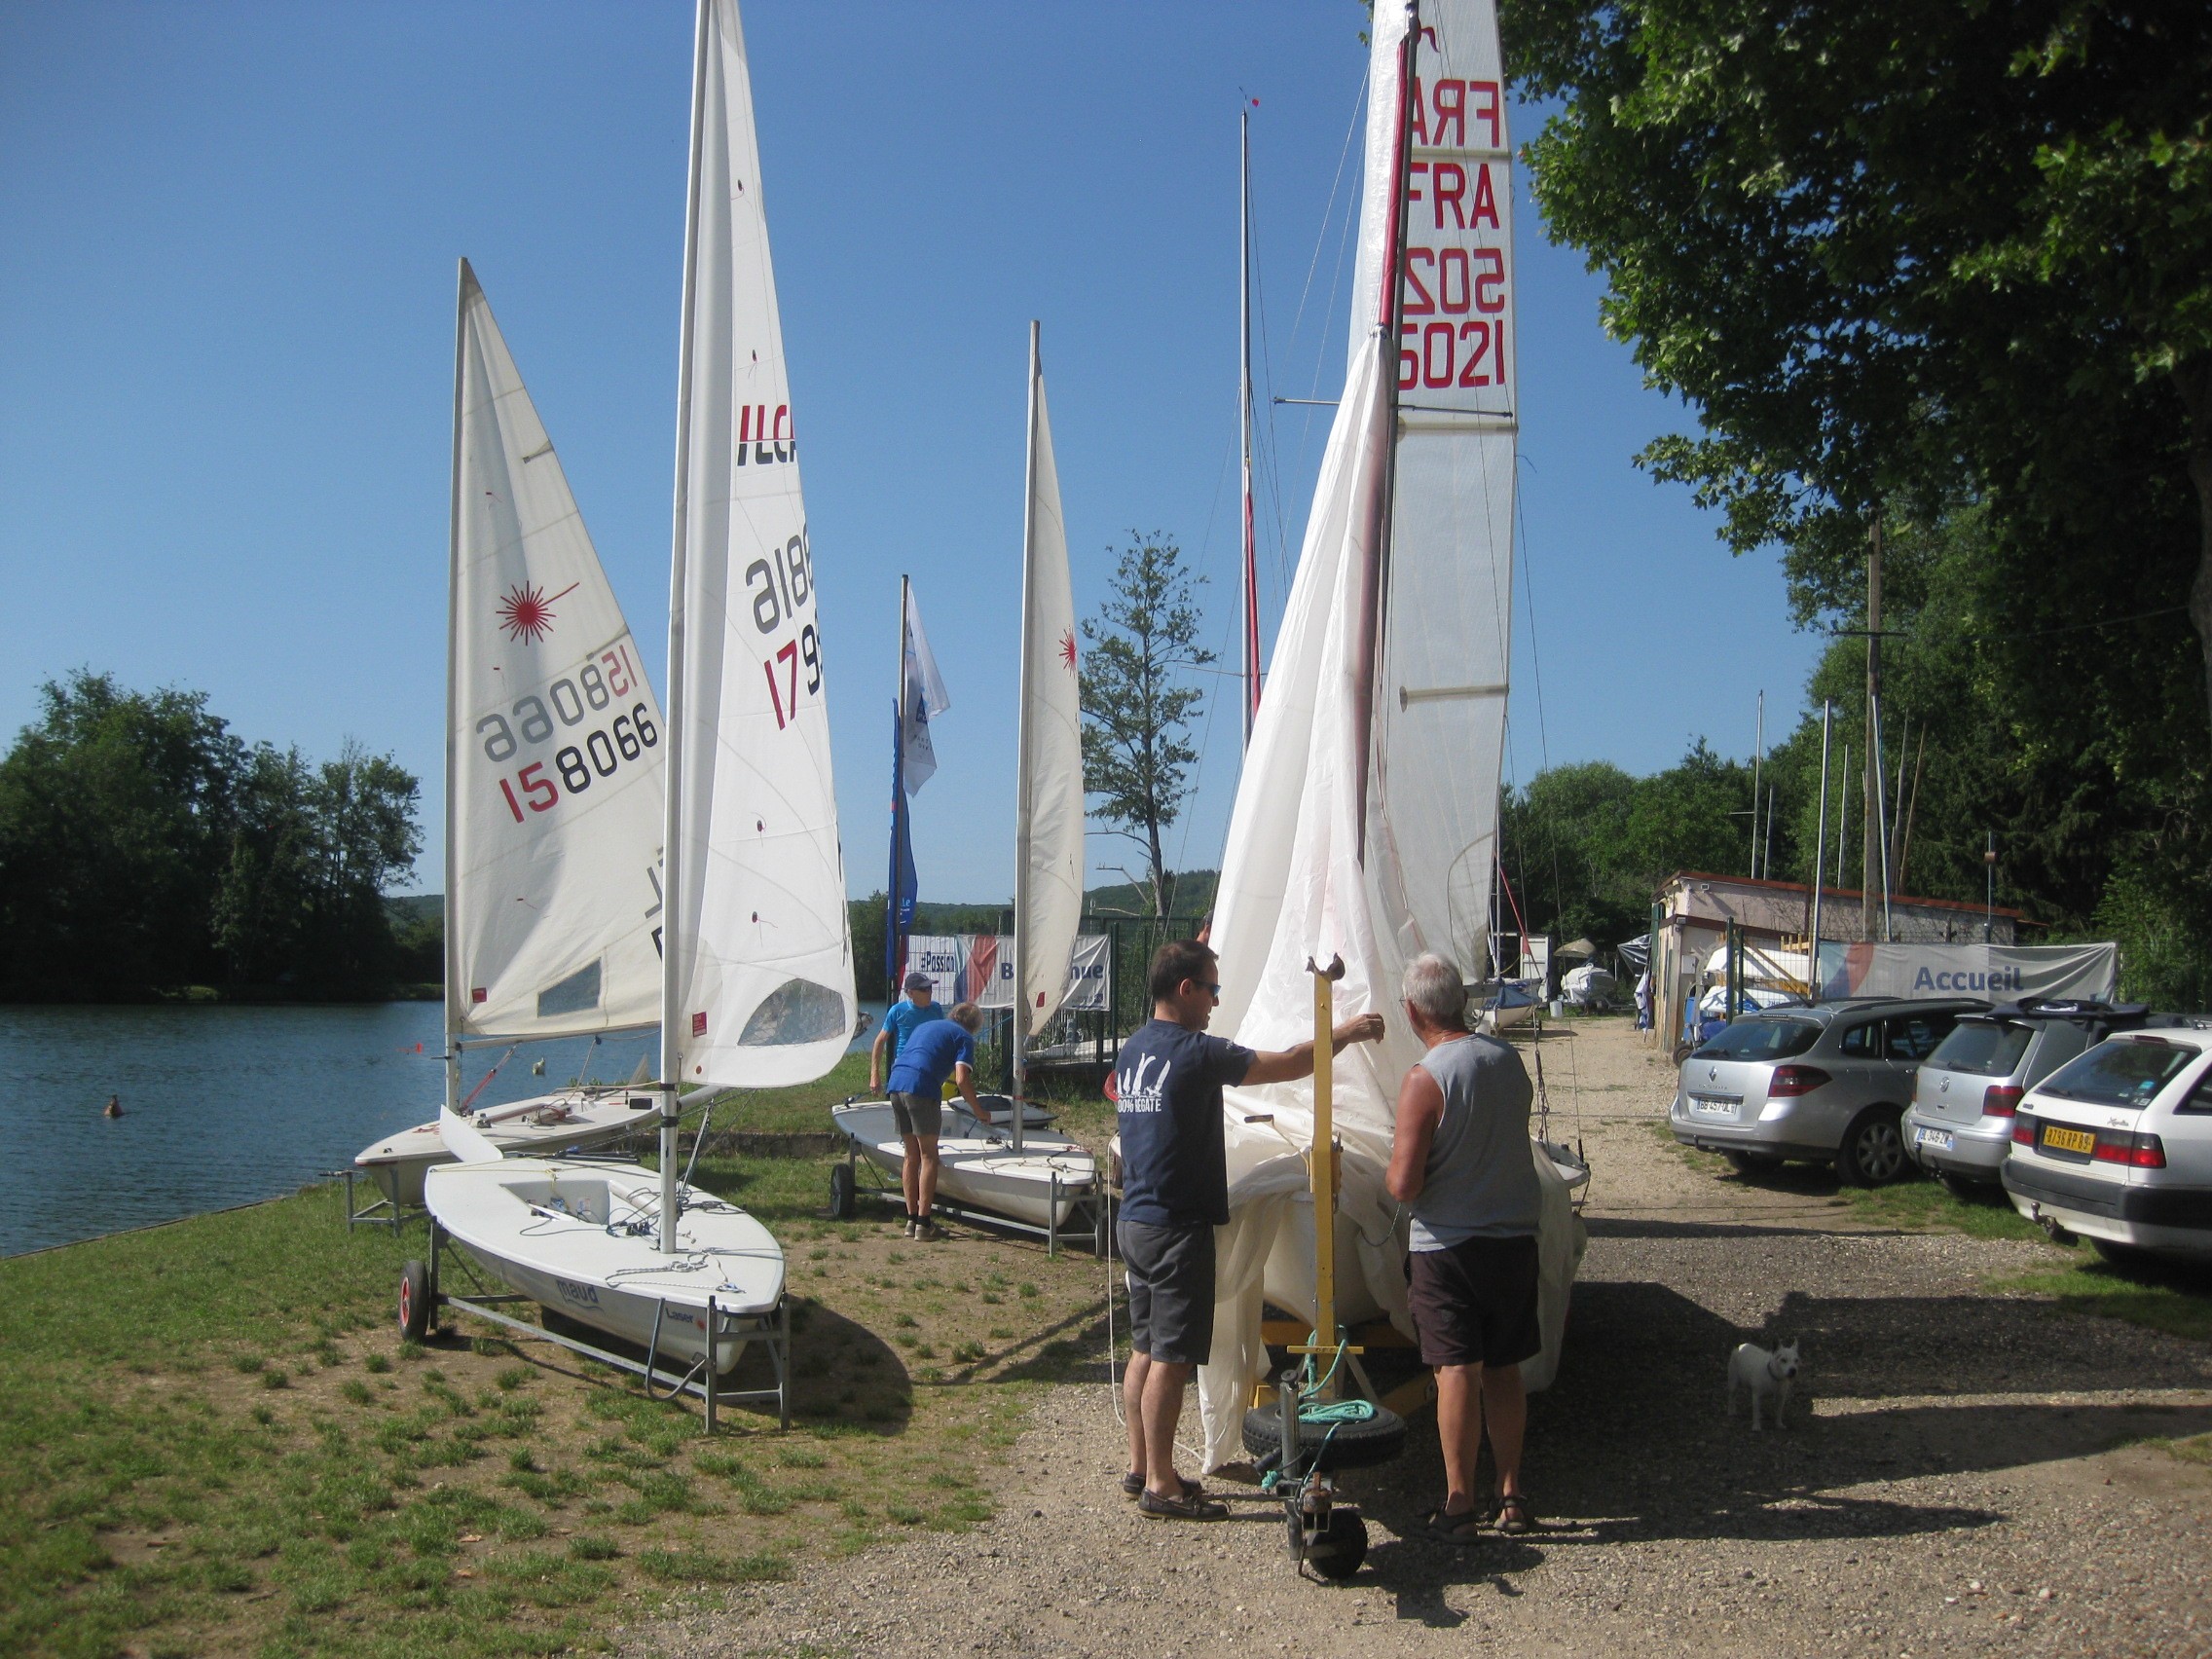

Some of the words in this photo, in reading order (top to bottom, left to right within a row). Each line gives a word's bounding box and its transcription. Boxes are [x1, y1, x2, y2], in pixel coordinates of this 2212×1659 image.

[1398, 319, 1505, 390] 5021
[764, 608, 824, 731] 179
[498, 702, 658, 824] 158066
[1913, 965, 2024, 992] Accueil
